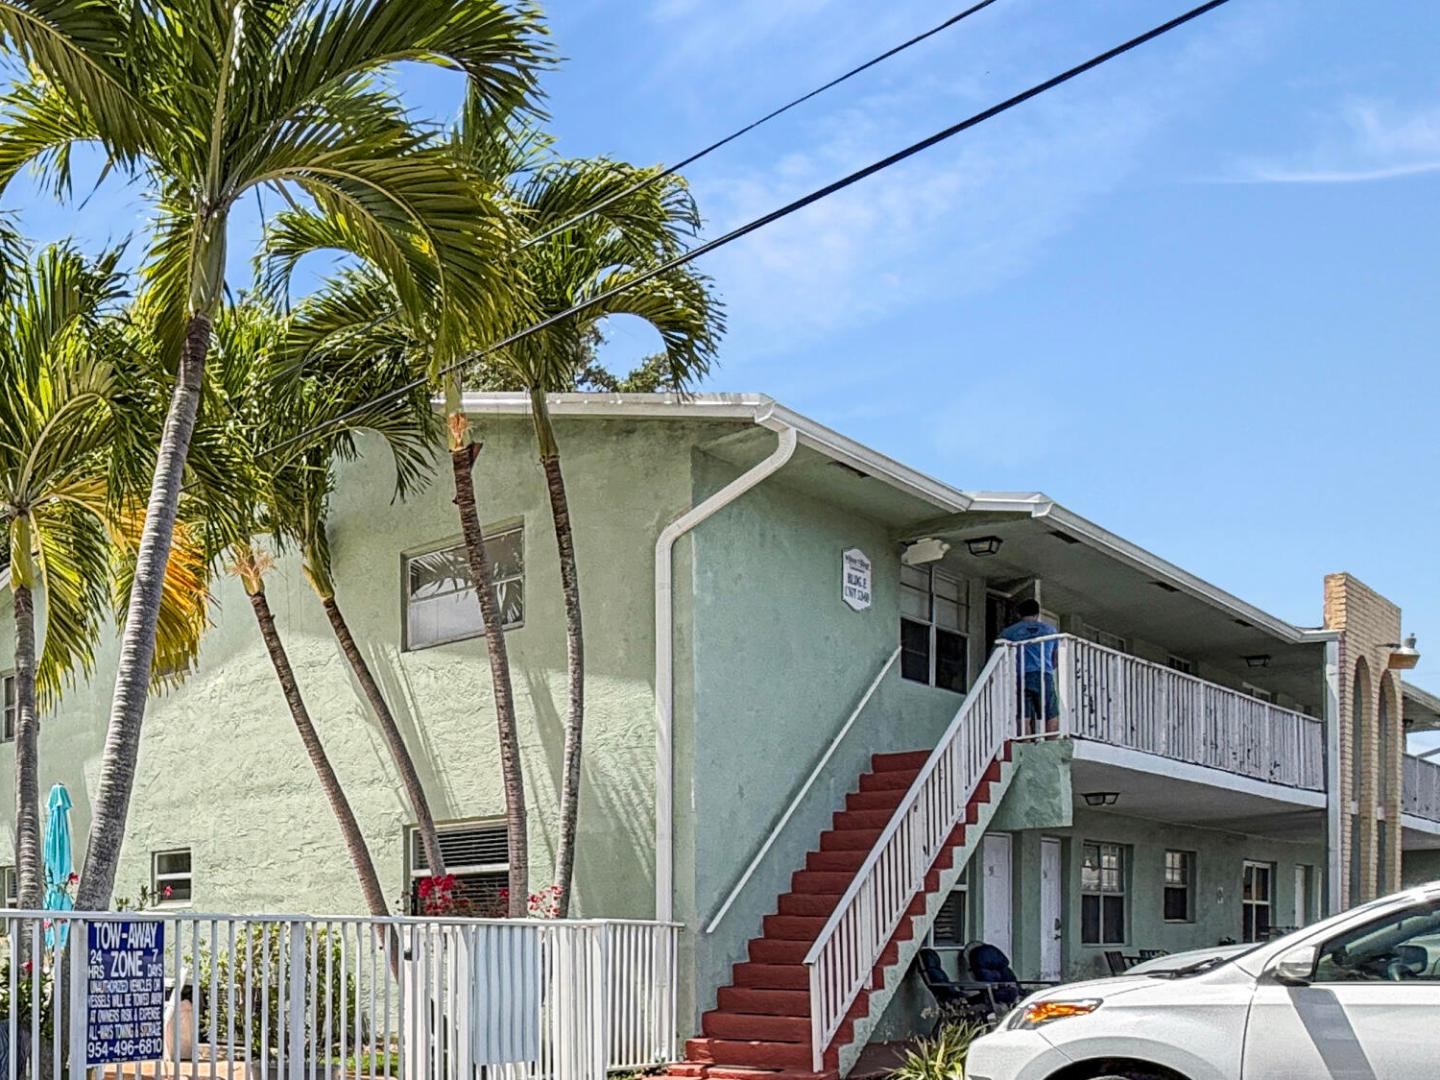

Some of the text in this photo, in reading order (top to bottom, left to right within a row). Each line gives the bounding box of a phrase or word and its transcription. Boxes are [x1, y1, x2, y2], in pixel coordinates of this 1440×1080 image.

[93, 922, 158, 949] TOW-AWAY
[90, 950, 102, 964] 24
[152, 949, 159, 962] 7
[110, 951, 143, 978] ZONE
[147, 964, 162, 977] DAYS
[88, 965, 105, 979] HRS
[88, 1038, 162, 1058] 954-496-6810
